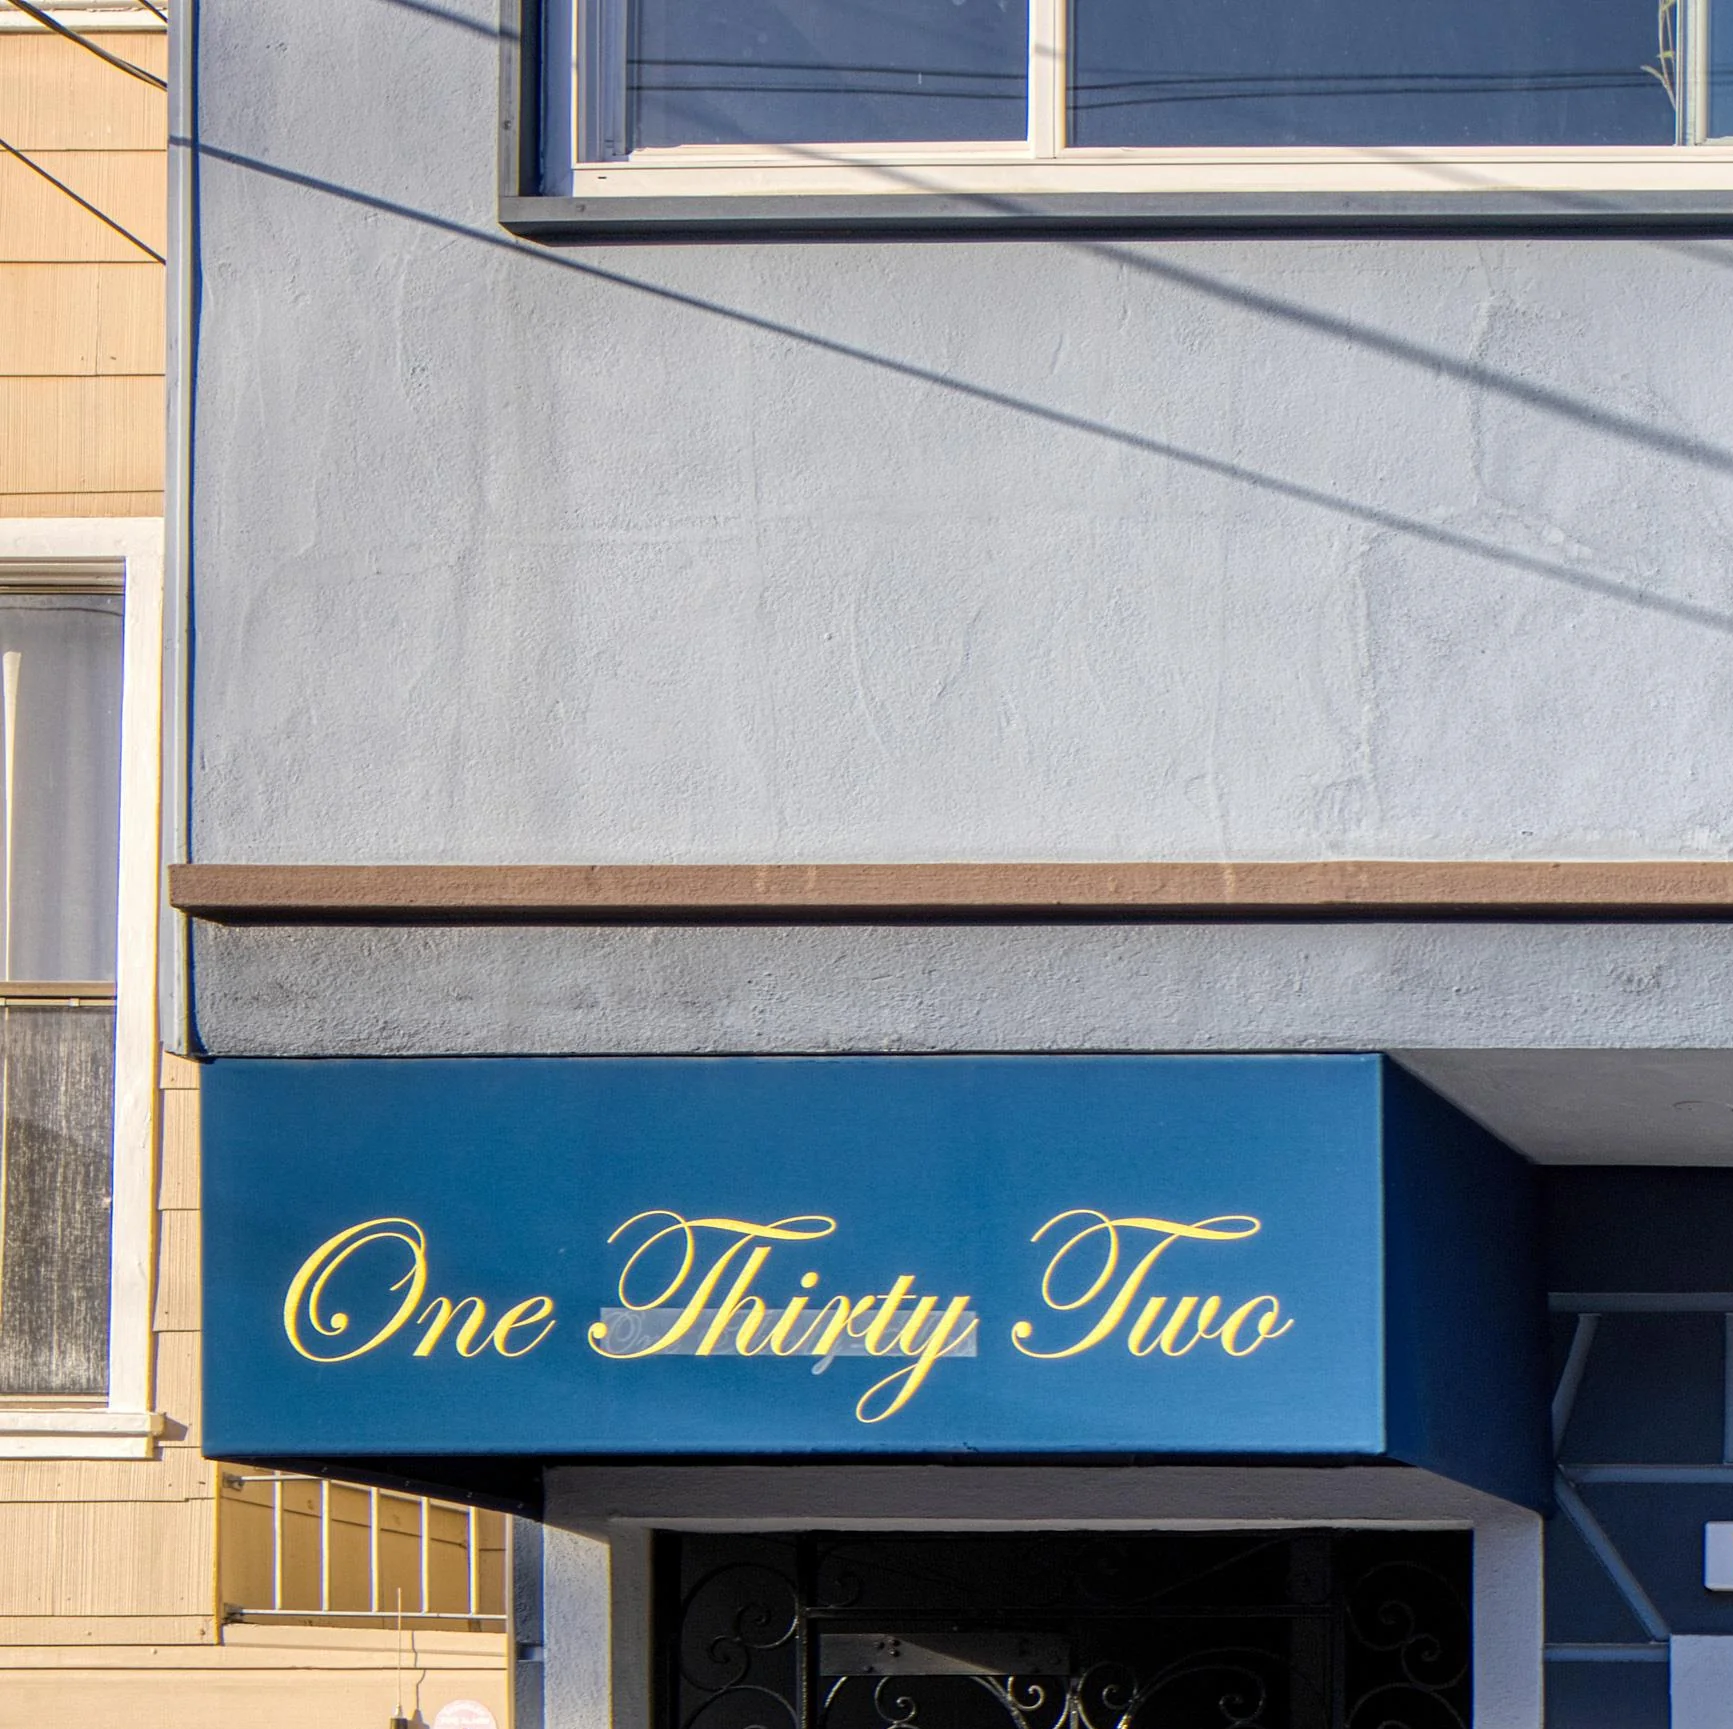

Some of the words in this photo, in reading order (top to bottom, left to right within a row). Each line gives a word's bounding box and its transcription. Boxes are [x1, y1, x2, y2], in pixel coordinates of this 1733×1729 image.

[283, 1216, 557, 1362] One
[587, 1209, 979, 1424] Thirty
[1010, 1208, 1294, 1359] Two
